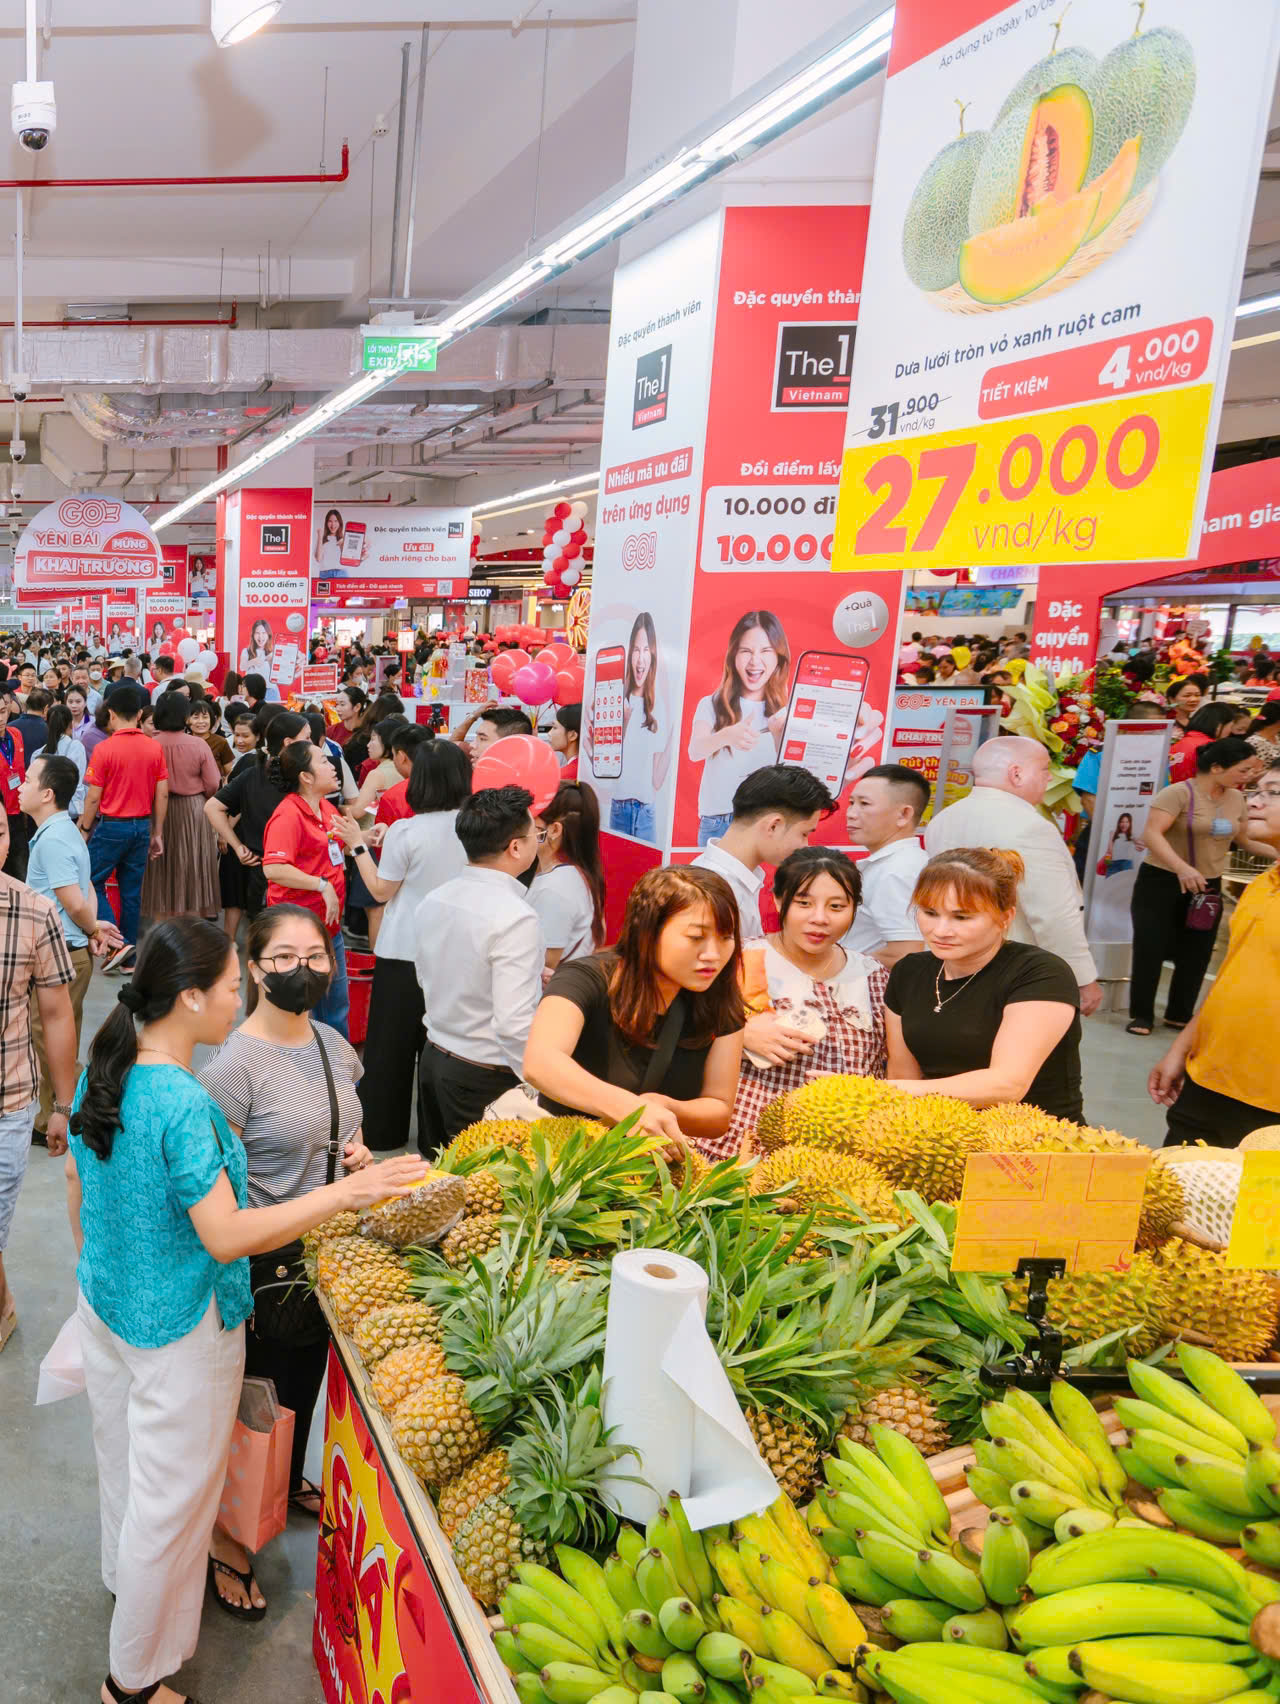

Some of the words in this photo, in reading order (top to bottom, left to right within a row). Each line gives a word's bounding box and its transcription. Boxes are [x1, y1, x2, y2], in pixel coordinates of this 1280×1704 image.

[955, 38, 981, 61] dụng
[995, 15, 1021, 40] ngày
[733, 291, 766, 308] Đặc
[770, 287, 823, 307] quyền
[827, 289, 861, 304] thà
[617, 334, 632, 348] Đặc
[632, 320, 656, 342] quyền
[657, 308, 681, 329] thành
[683, 299, 702, 317] viên
[894, 361, 920, 379] Dưa
[924, 353, 951, 371] lưới
[954, 344, 984, 364] tròn
[989, 333, 1009, 355] vỏ
[1013, 324, 1053, 349] xanh
[1057, 315, 1095, 337] ruột
[1101, 303, 1142, 327] cam
[369, 357, 393, 367] EXIT
[1135, 360, 1192, 385] vnd/kg
[789, 389, 843, 400] Vietnam
[981, 380, 1011, 403] TIẾT
[1014, 375, 1049, 396] KIỆM
[637, 406, 663, 424] Vietnam
[899, 416, 936, 434] vnd/kg
[607, 464, 635, 489] Nhiều
[637, 462, 653, 481] mã
[655, 459, 669, 478] ưu
[671, 453, 689, 474] đãi
[740, 460, 769, 477] Đổi
[773, 459, 814, 476] điểm
[818, 460, 841, 478] lấy
[853, 413, 1161, 557] 27.000
[602, 503, 626, 525] trên
[629, 499, 652, 522] ứng
[655, 493, 691, 519] dụng
[724, 497, 806, 515] 10.000
[34, 528, 68, 547] YÊN
[71, 529, 99, 547] BÁI
[112, 536, 148, 550] MỪNG
[374, 525, 387, 533] Đặc
[388, 525, 410, 535] quyền
[411, 525, 431, 533] thành
[432, 525, 447, 533] viên
[973, 506, 1098, 551] vnd/kg
[34, 556, 79, 575] KHAI
[80, 556, 154, 577] TRƯƠNG
[379, 554, 400, 562] dành
[401, 554, 423, 564] riêng
[247, 581, 275, 589] 10.000
[277, 580, 297, 588] điểm
[468, 588, 492, 597] SHOP
[245, 593, 289, 603] 10.000
[1048, 600, 1083, 621] Đặc
[1035, 626, 1089, 649] quyền
[935, 696, 956, 706] YÊN
[960, 697, 979, 706] BÁI
[898, 731, 924, 742] KHAI
